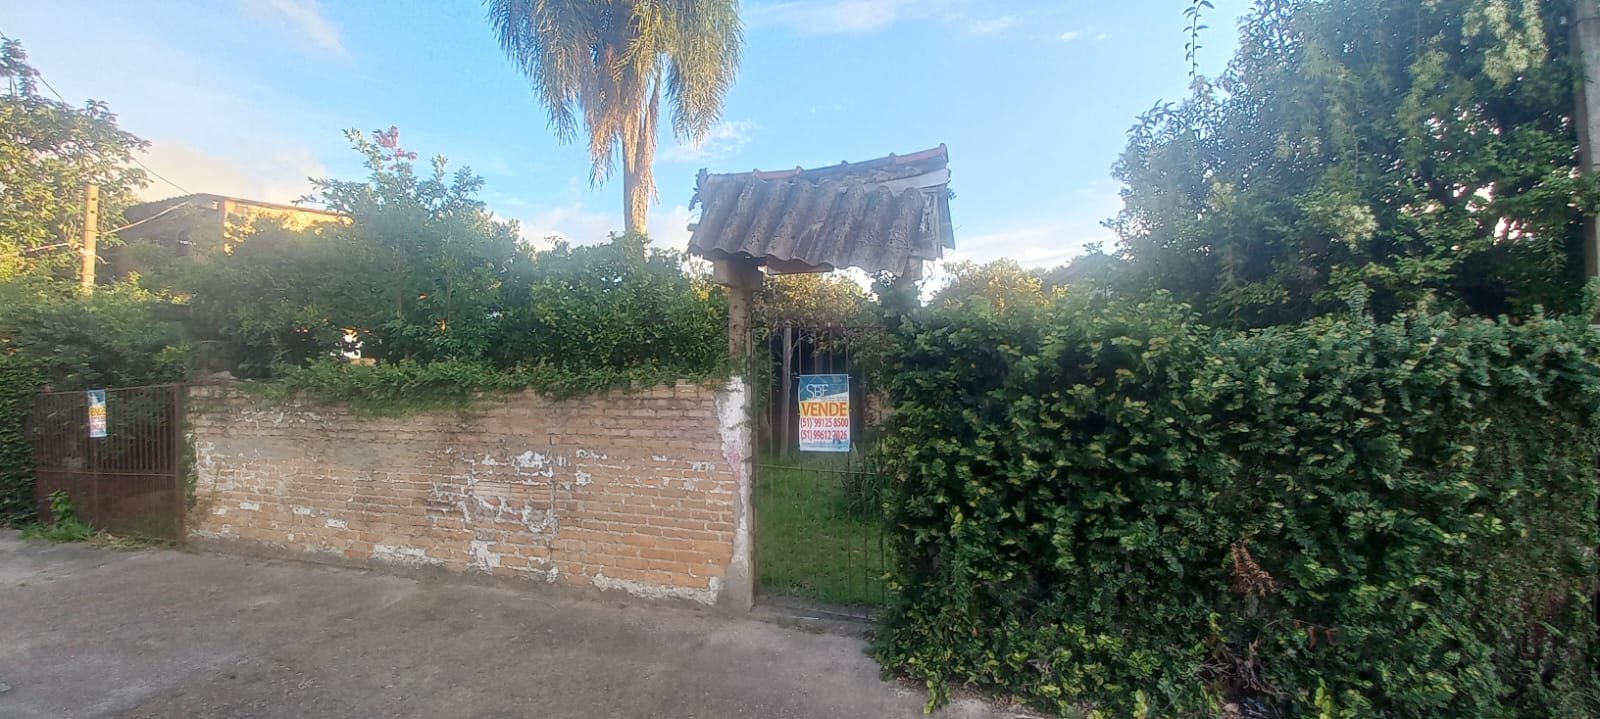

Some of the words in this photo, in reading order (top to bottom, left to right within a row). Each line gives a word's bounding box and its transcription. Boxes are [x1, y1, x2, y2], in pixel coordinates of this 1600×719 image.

[801, 402, 848, 417] VENDE
[801, 417, 812, 428] (51)
[814, 417, 832, 427] 99125
[801, 430, 812, 441] (51)
[813, 430, 832, 440] 99612
